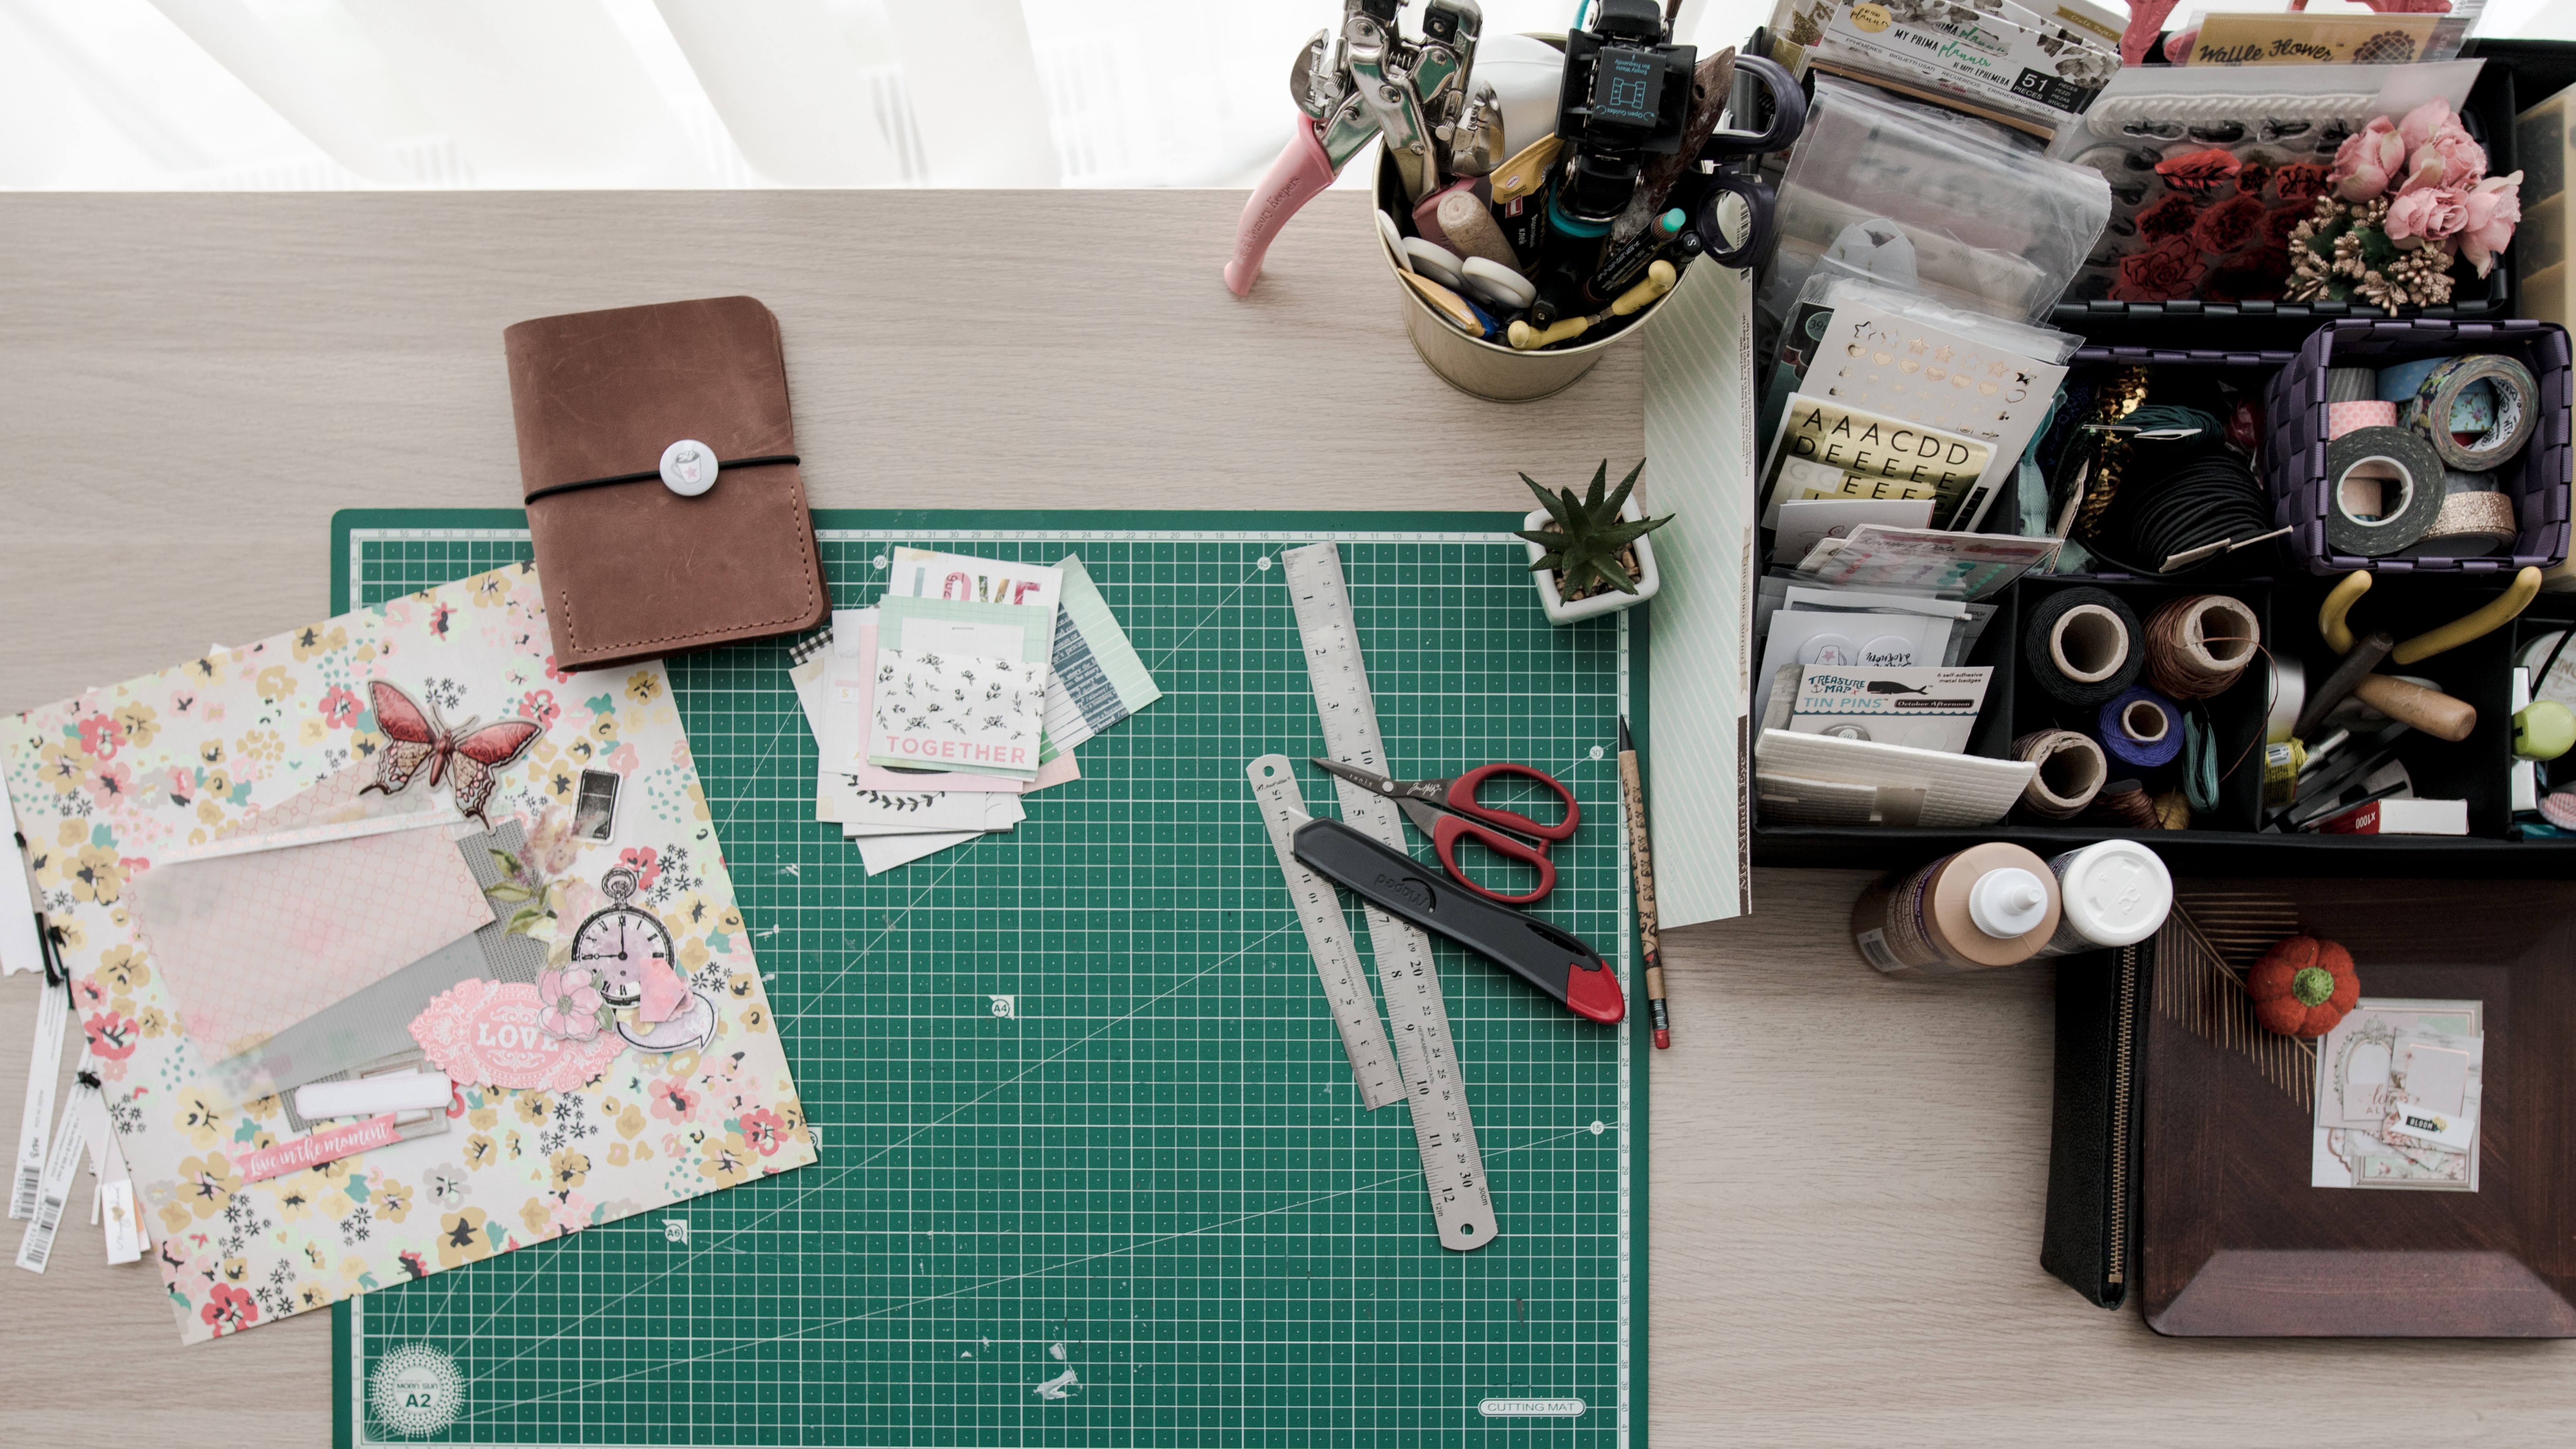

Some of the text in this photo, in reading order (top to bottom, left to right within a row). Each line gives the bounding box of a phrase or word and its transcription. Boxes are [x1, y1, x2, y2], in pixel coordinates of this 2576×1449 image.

[1850, 8, 1890, 27] planner
[1894, 29, 1991, 68] MY PRIMA planner
[2200, 39, 2333, 64] Waffle Flower
[1614, 59, 1641, 69] Frequently
[1918, 62, 1935, 72] USATI
[1942, 71, 1981, 88] RECUERDOS
[1959, 63, 1973, 74] HAPPY
[1975, 69, 2010, 87] EPHEMERA
[2022, 73, 2047, 92] 51
[2013, 86, 2043, 100] PIECES
[2055, 87, 2071, 96] PEZZI
[2051, 93, 2070, 103] PIEZAS
[1607, 108, 1627, 116] Guides
[1244, 207, 1273, 241] Memory
[1267, 176, 1300, 209] Keepers
[839, 531, 848, 539] 35
[949, 531, 959, 539] 30
[1060, 531, 1069, 539] 25
[1170, 531, 1180, 539] 20
[1281, 532, 1291, 540] 15
[1392, 532, 1402, 540] 10
[1505, 532, 1510, 540] 5
[1074, 666, 1099, 682] the story
[1808, 675, 1865, 689] TREASURE
[842, 689, 848, 698] S
[1824, 685, 1851, 693] MAP
[1804, 698, 1833, 707] TIN
[1931, 701, 1970, 709] Afternoon
[886, 736, 1026, 764] TOGETHER
[1361, 750, 1374, 765] 10
[1349, 774, 1373, 788] tonic
[1272, 789, 1282, 801] 15
[1737, 794, 1748, 853] Mind's
[2355, 811, 2376, 830] x1000
[1621, 863, 1628, 873] 15
[1302, 873, 1311, 884] 11
[1739, 861, 1747, 890] My
[1375, 874, 1429, 906] Maped
[1309, 892, 1318, 904] 10
[1407, 942, 1416, 953] 19
[1391, 970, 1402, 979] 8
[1410, 960, 1424, 977] 20
[1417, 984, 1427, 995] 21
[994, 1004, 1008, 1012] A4
[1422, 1005, 1431, 1017] 22
[476, 1023, 559, 1052] LOVE
[1427, 1026, 1437, 1038] 23
[1432, 1047, 1442, 1059] 24
[1426, 1065, 1435, 1085] СТАЛЬ
[1437, 1068, 1447, 1080] 25
[1417, 1078, 1430, 1096] 10
[1621, 1081, 1628, 1090] 25
[1442, 1089, 1451, 1101] 26
[1447, 1111, 1457, 1121] 27
[2409, 1118, 2434, 1130] BLOOM
[1430, 1133, 1443, 1148] 11
[1452, 1132, 1461, 1143] 28
[250, 1124, 391, 1177] Live in the moment
[1457, 1152, 1466, 1164] 29
[1460, 1171, 1473, 1188] 30
[1442, 1186, 1455, 1203] 12
[1479, 1186, 1489, 1206] 30cm
[1435, 1202, 1444, 1218] 12in
[1621, 1295, 1628, 1305] 35
[397, 1382, 420, 1390] MORN
[405, 1394, 431, 1408] A2
[1488, 1403, 1575, 1412] CUTTING MAT
